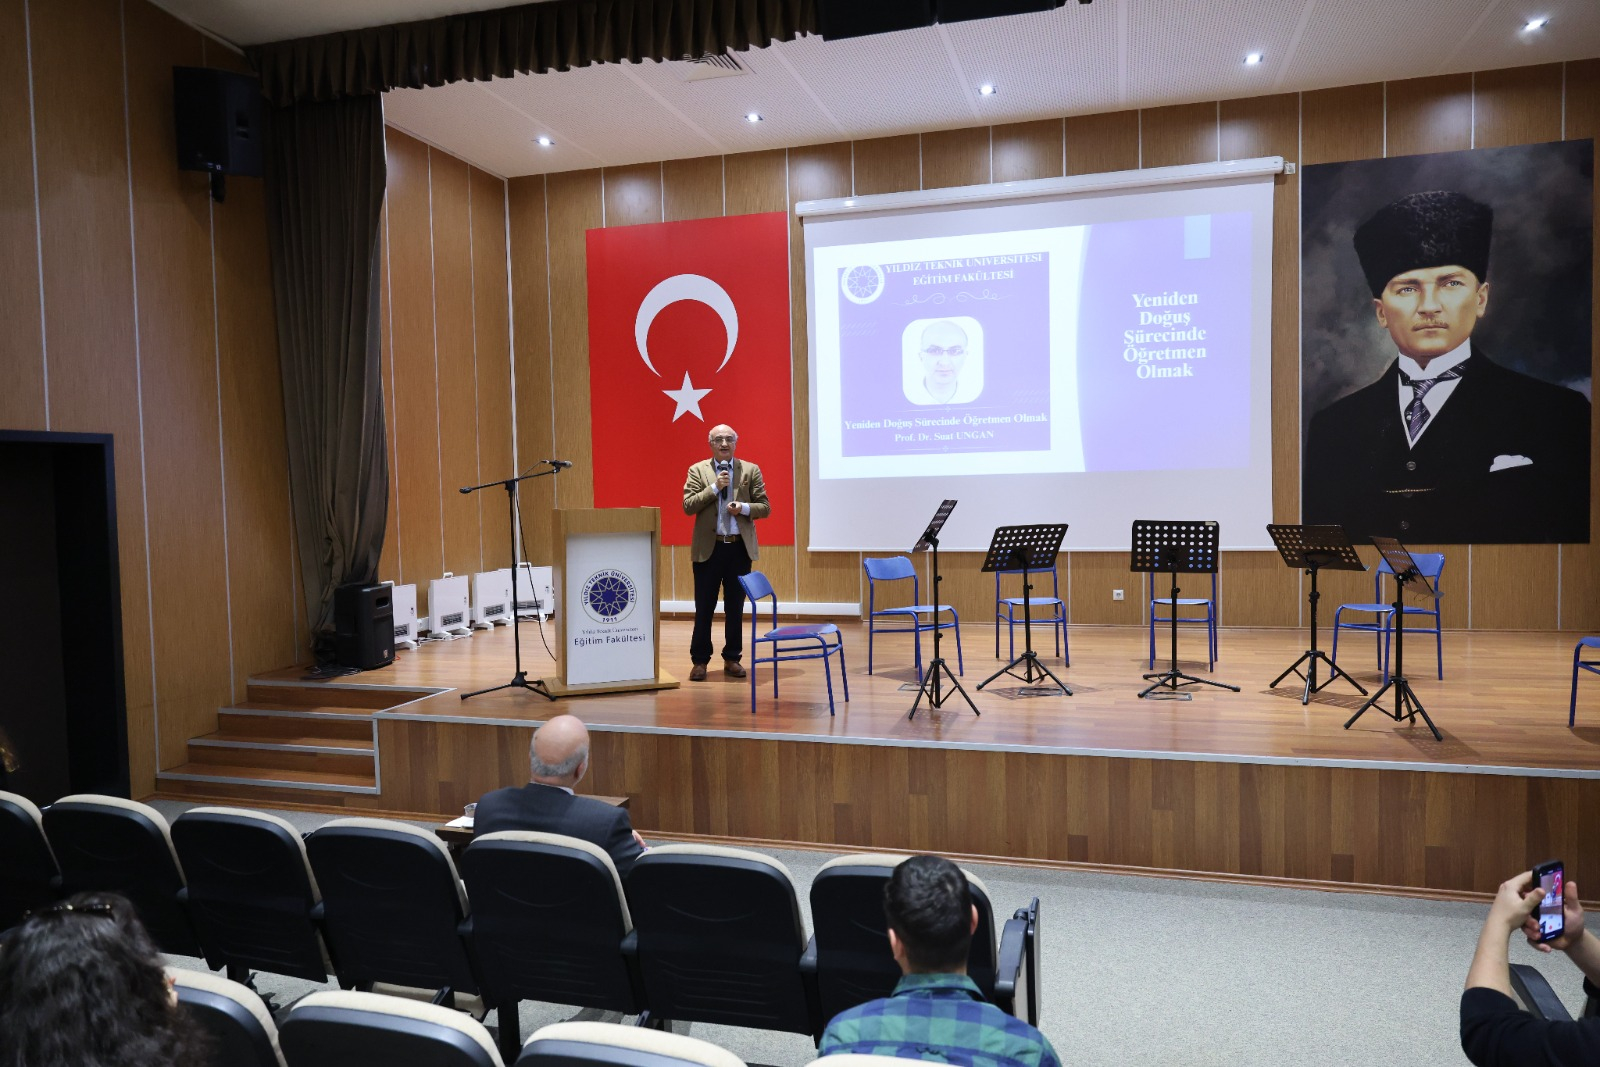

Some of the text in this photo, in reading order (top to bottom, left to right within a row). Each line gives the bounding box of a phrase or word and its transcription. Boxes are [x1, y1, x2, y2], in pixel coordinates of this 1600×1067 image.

[913, 268, 1014, 286] EĞİTİM FAKÜLTESİ
[1132, 291, 1199, 308] Yeniden
[1139, 310, 1191, 328] Doğuş
[1123, 326, 1207, 345] Sürecinde
[1123, 344, 1207, 364] Öğretmen
[1136, 363, 1194, 379] Olmak
[844, 412, 1048, 430] Yeniden Doğuş Sürecinde Öğretmen Olmak
[894, 430, 994, 442] Prof. Dr. Suat UNGAN
[574, 633, 646, 648] Eğitim Fakültesi
